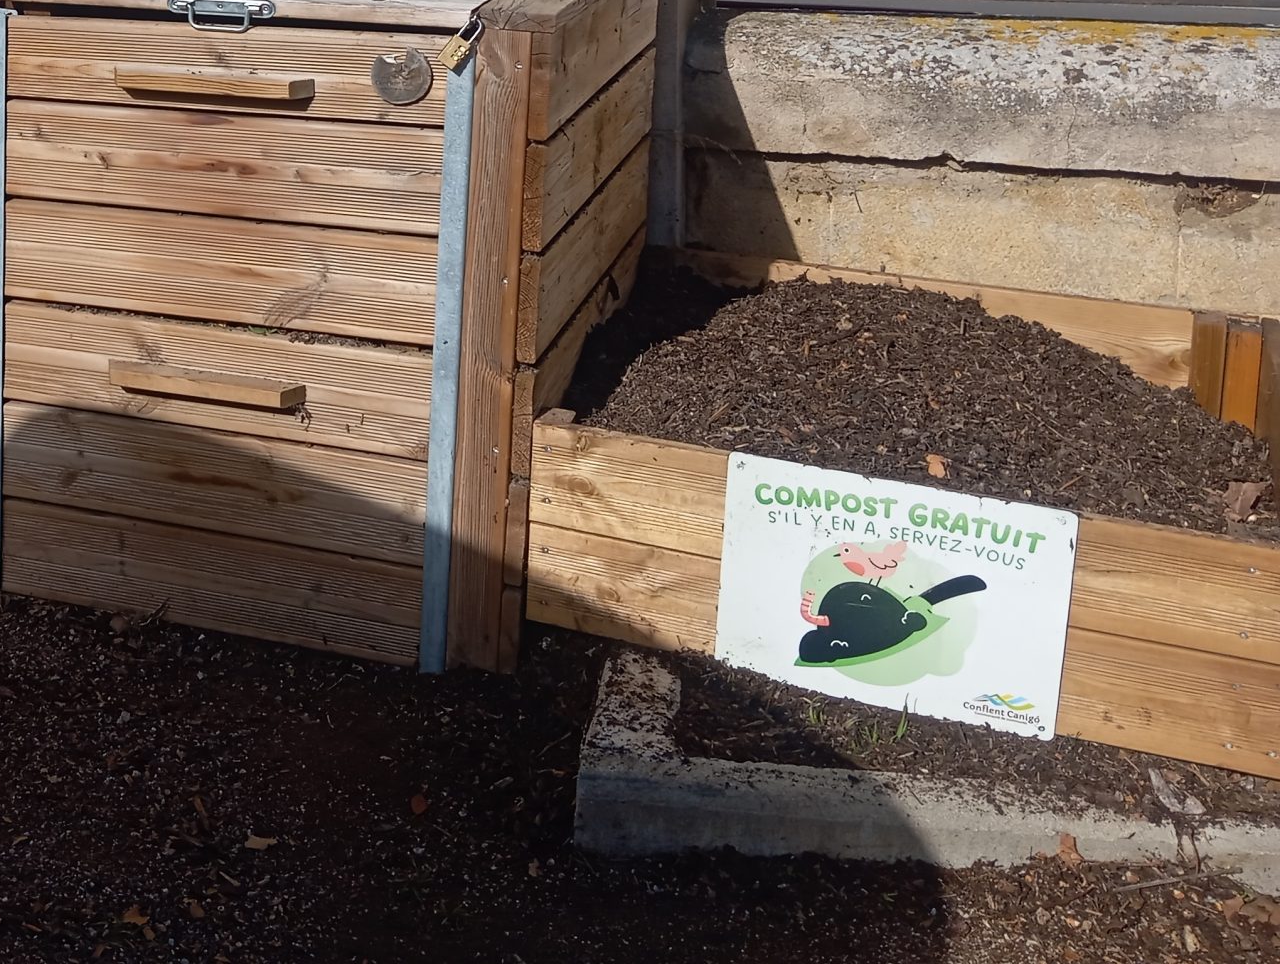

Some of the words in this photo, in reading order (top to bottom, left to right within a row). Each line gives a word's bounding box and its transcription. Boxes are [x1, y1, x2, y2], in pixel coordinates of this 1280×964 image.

[754, 483, 898, 519] COMPOST
[908, 503, 1046, 553] GRATUIT
[768, 510, 803, 527] S'IL
[810, 513, 823, 527] Y
[832, 516, 855, 532] EN
[864, 521, 881, 539] A,
[889, 526, 1026, 570] SERVEZ-VOUS
[962, 701, 1005, 717] Conflent
[1006, 710, 1041, 725] Canigó
